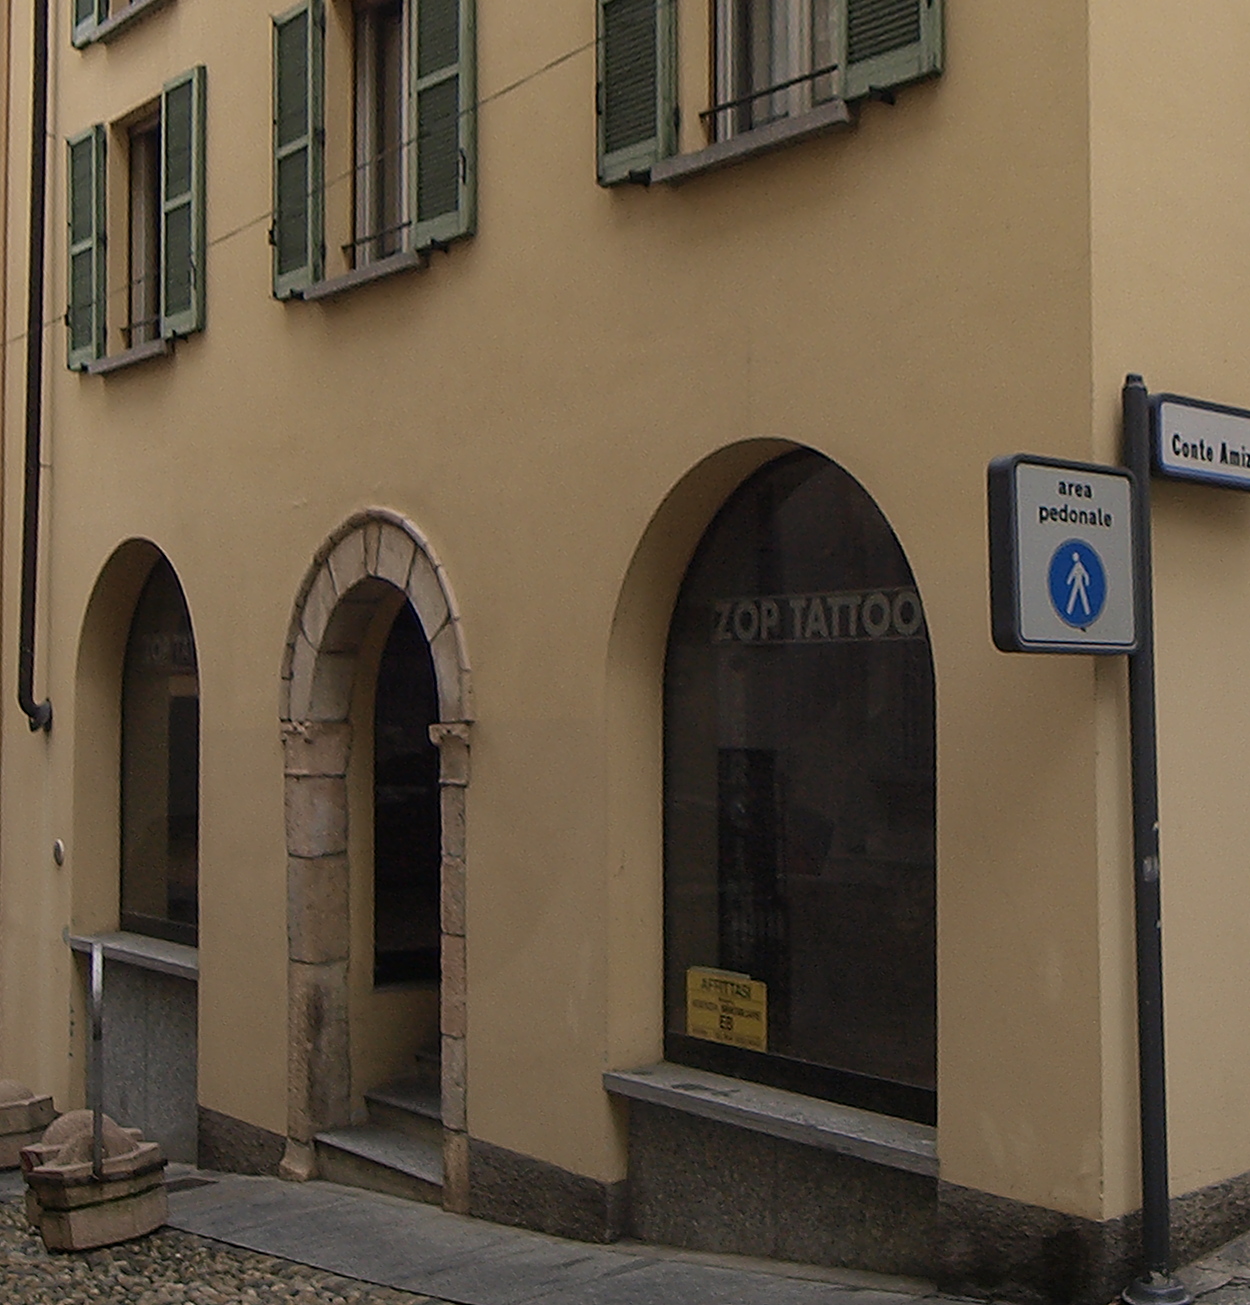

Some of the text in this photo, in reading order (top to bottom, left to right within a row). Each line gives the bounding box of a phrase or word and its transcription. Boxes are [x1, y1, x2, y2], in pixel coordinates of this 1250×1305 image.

[1171, 433, 1213, 462] Conte
[1058, 481, 1093, 499] area
[1038, 503, 1112, 527] pedonale
[714, 591, 922, 642] ZOP TATTOO
